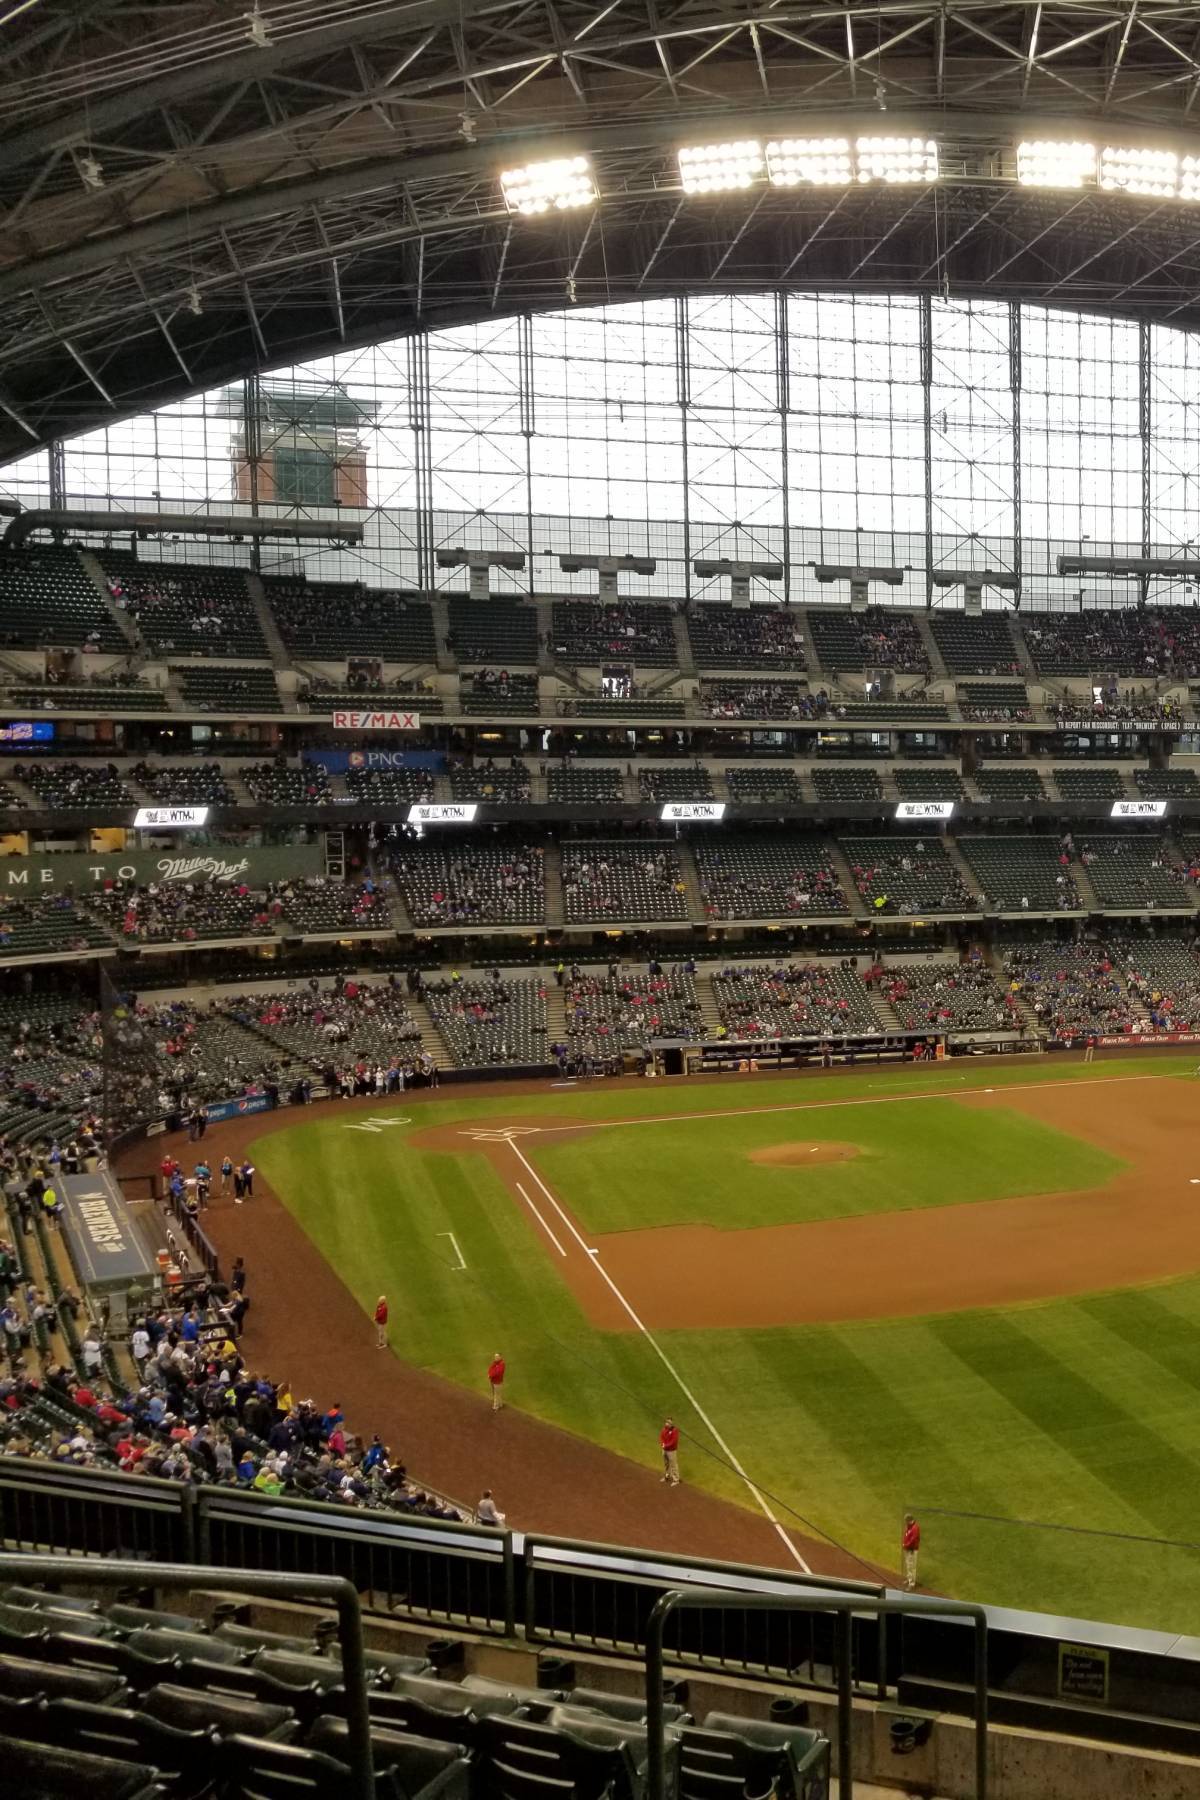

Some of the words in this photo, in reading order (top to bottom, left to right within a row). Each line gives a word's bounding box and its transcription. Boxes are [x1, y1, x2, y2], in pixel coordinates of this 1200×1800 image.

[335, 713, 415, 728] RE/MAX
[368, 752, 405, 766] PNC
[156, 856, 214, 882] Miller
[203, 857, 249, 881] Park
[78, 1199, 122, 1242] BREWERS
